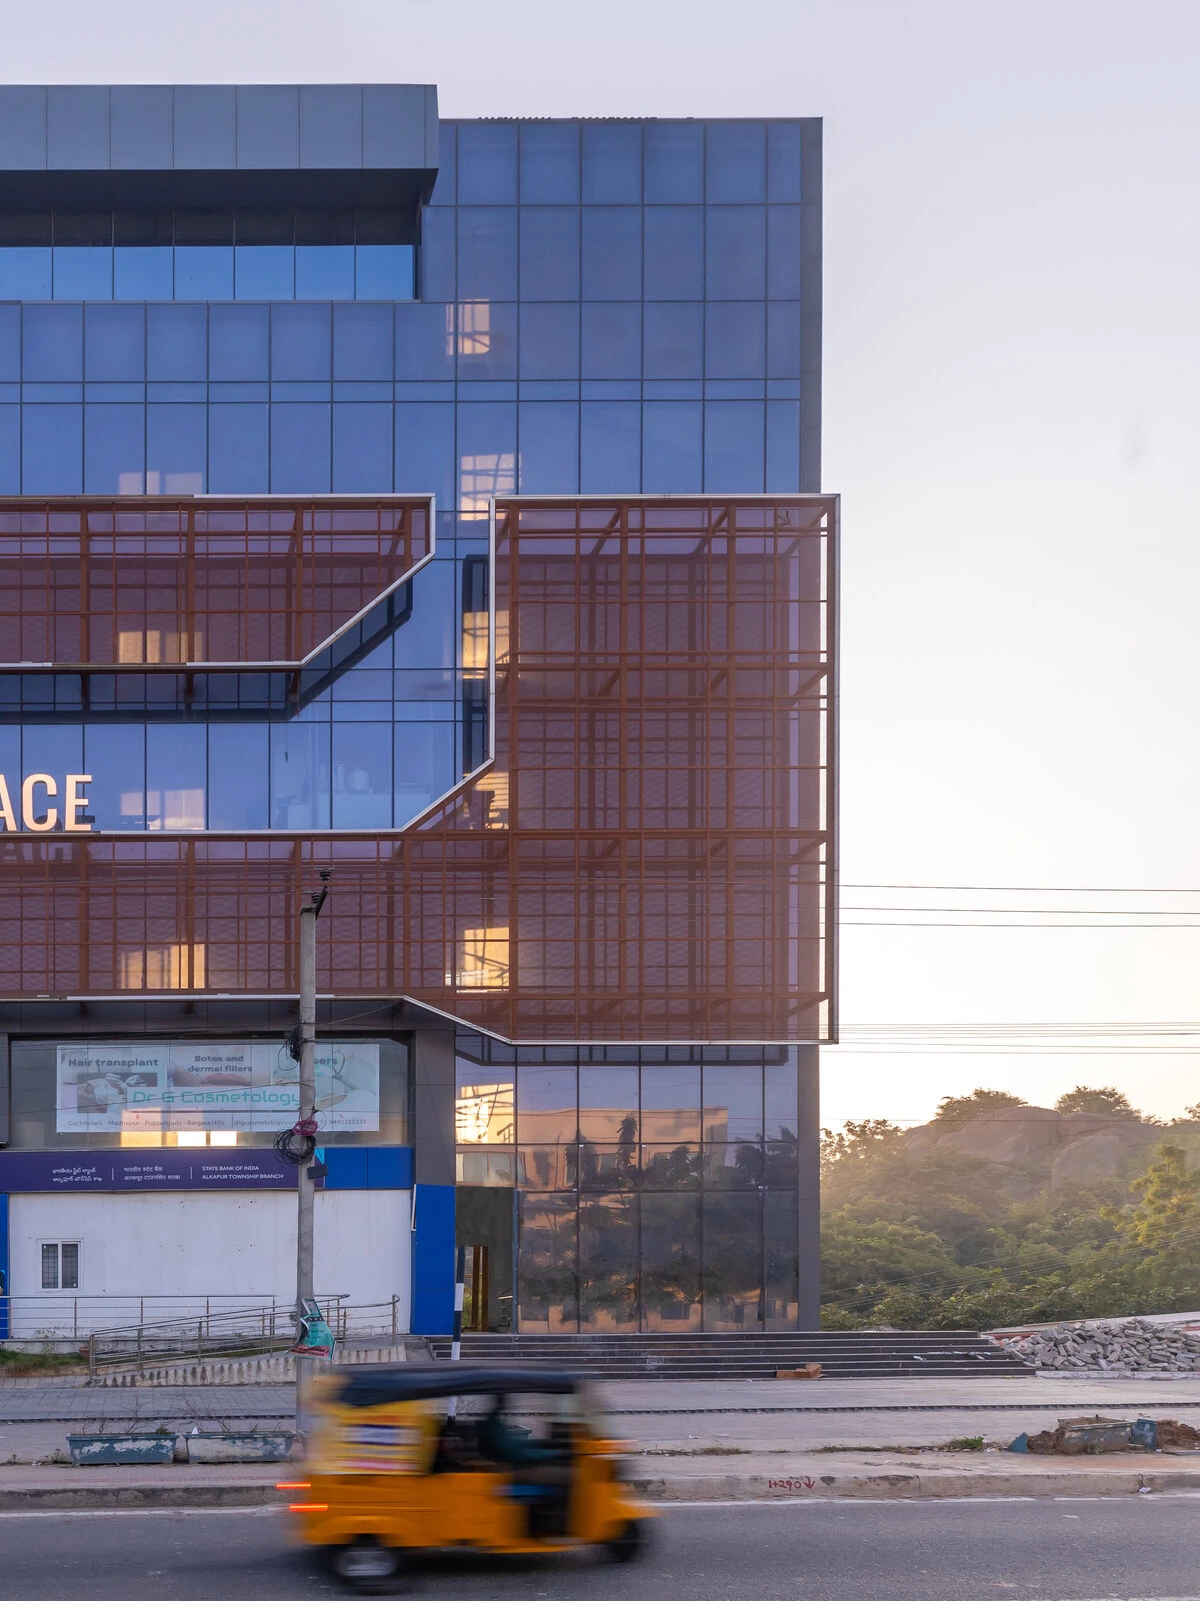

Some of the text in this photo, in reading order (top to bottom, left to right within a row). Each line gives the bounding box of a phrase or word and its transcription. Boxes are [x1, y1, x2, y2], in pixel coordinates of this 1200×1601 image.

[68, 1058, 159, 1069] Hair transplant
[187, 1065, 223, 1073] dermal
[133, 1090, 300, 1106] Dr G Cosmetology
